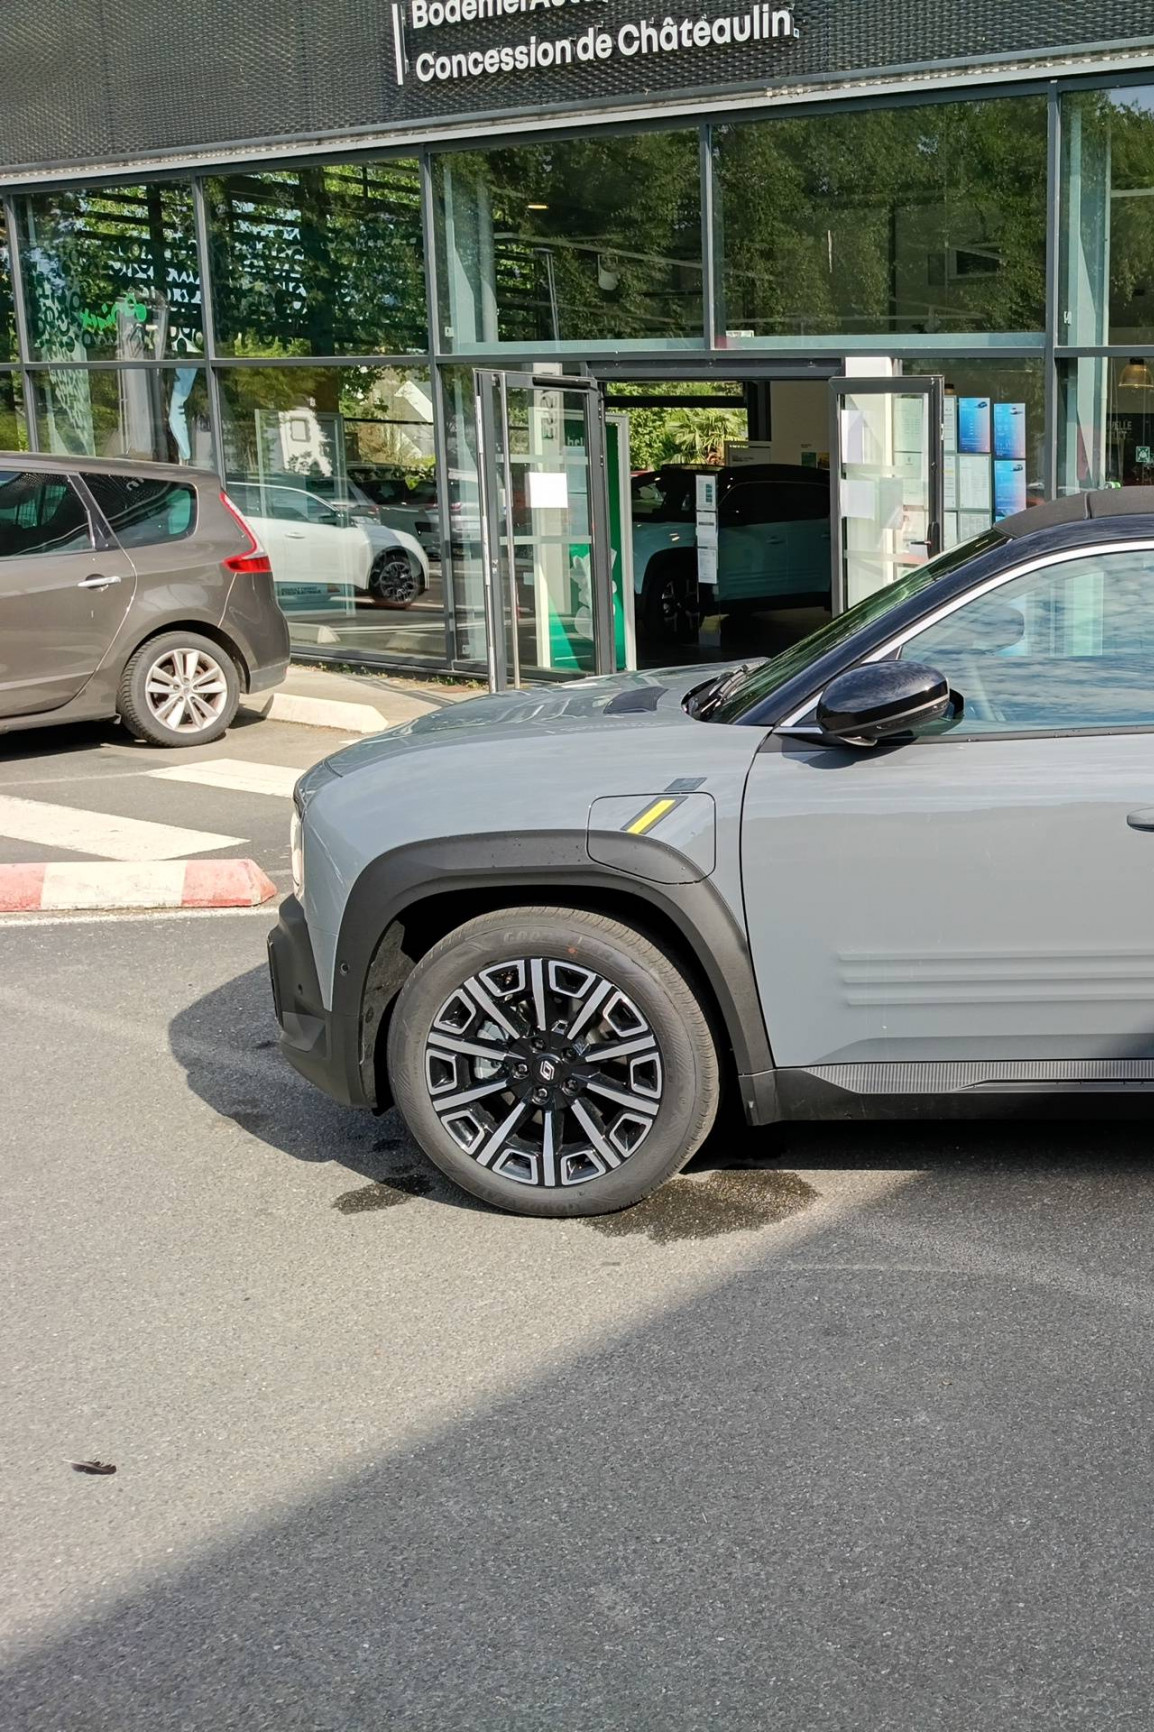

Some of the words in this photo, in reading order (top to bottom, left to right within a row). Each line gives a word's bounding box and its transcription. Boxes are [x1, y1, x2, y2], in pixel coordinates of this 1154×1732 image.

[416, 36, 572, 82] Concession
[576, 27, 613, 61] de
[618, 3, 791, 56] Châteaulin
